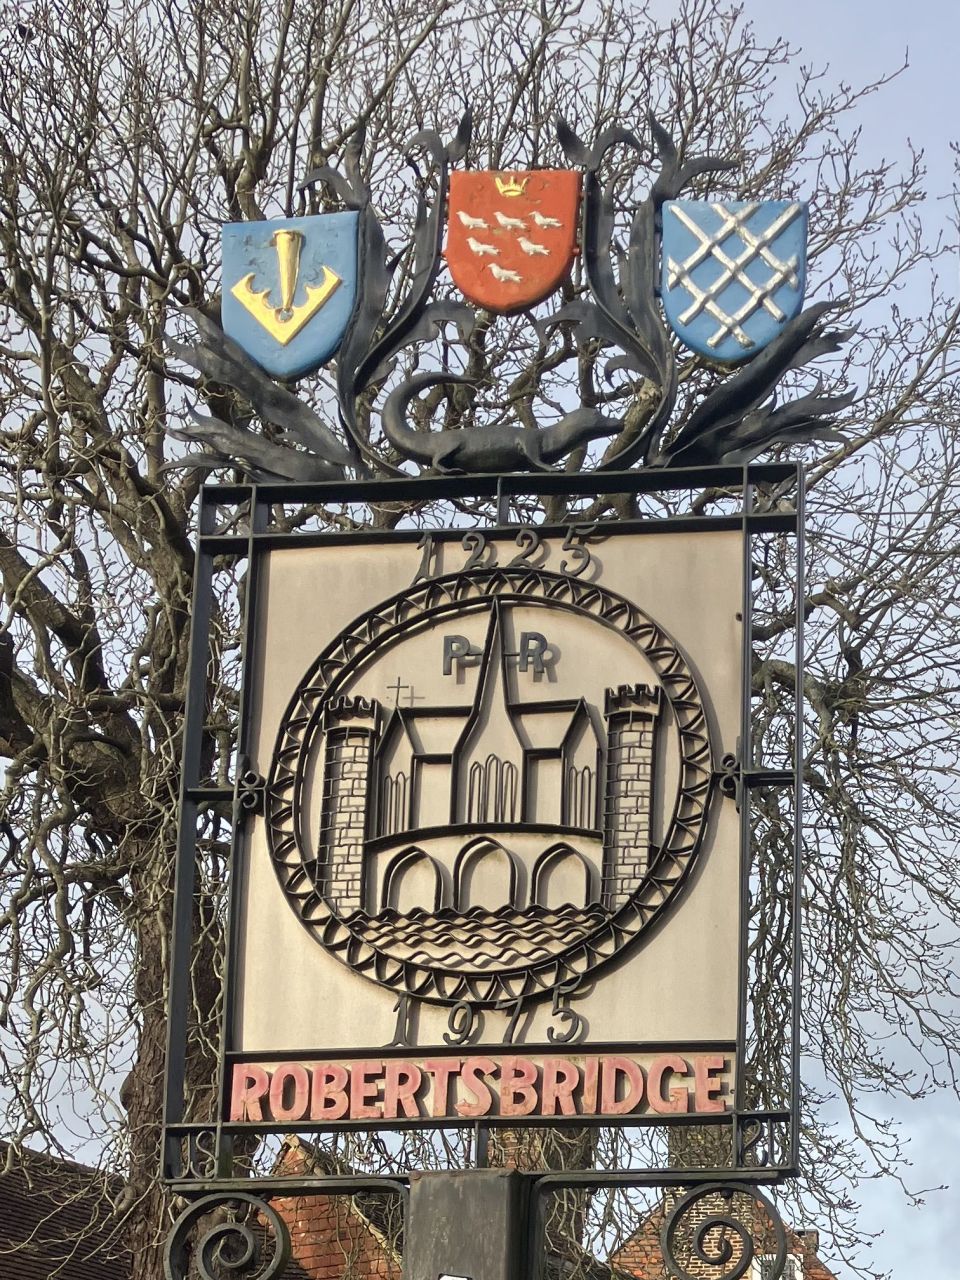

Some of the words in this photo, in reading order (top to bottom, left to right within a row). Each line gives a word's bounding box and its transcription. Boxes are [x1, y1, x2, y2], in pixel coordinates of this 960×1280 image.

[411, 523, 597, 587] 1225
[443, 635, 471, 676] P
[519, 631, 548, 674] R
[384, 974, 582, 1046] 1975
[230, 1054, 726, 1122] ROBERTSBRIDGE
